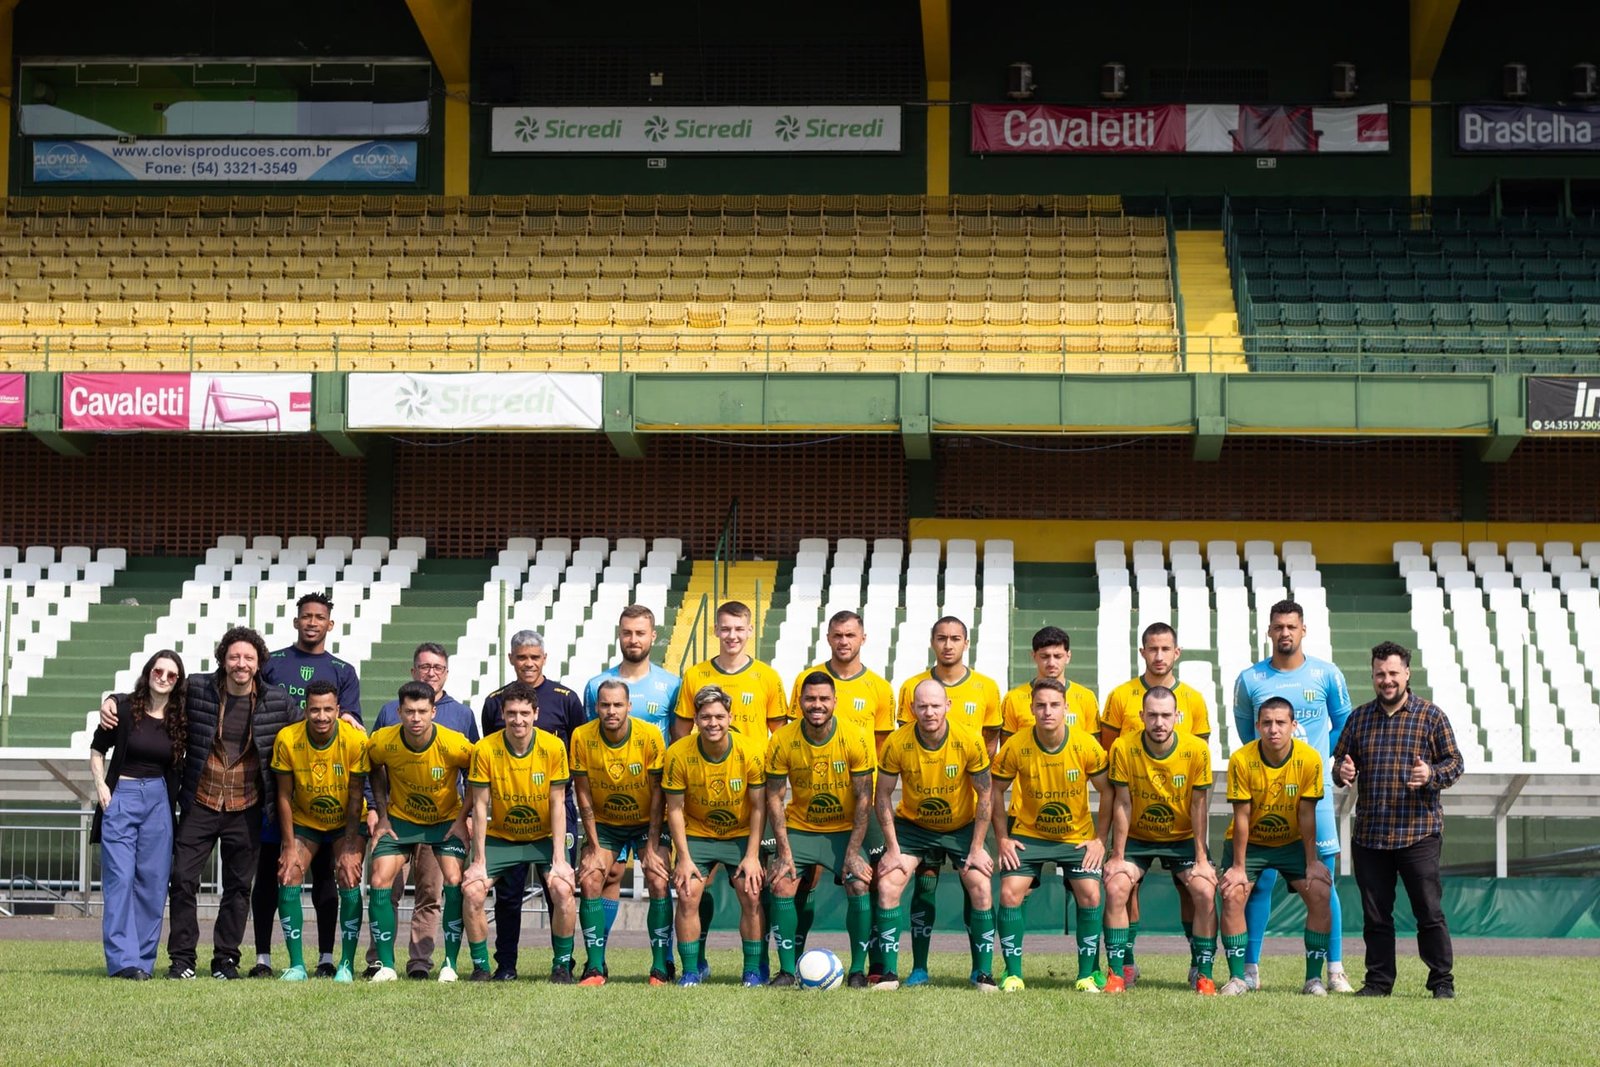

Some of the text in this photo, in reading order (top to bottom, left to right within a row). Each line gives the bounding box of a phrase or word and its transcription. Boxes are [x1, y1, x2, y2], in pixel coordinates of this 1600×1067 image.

[544, 119, 623, 138] Sicredi
[674, 119, 752, 138] Sicredi
[805, 118, 884, 138] Sicredi
[1003, 109, 1155, 147] Cavaletti
[1464, 113, 1592, 144] Brastelha
[112, 144, 332, 160] www.clovisproducoes.com.br
[145, 161, 297, 177] Fone: (54) 3321-3549
[70, 386, 184, 416] Cavaletti
[439, 385, 555, 415] Sicredi
[1544, 420, 1579, 430] 54.3519
[1294, 708, 1322, 718] risul
[503, 793, 549, 803] banrisu
[1036, 789, 1082, 799] banrisu
[603, 803, 639, 811] Aurora
[807, 805, 843, 814] Aurora
[504, 816, 541, 825] Aurora
[1036, 814, 1073, 824] Aurora
[1140, 813, 1175, 823] Aurora
[1253, 824, 1290, 832] Aurora
